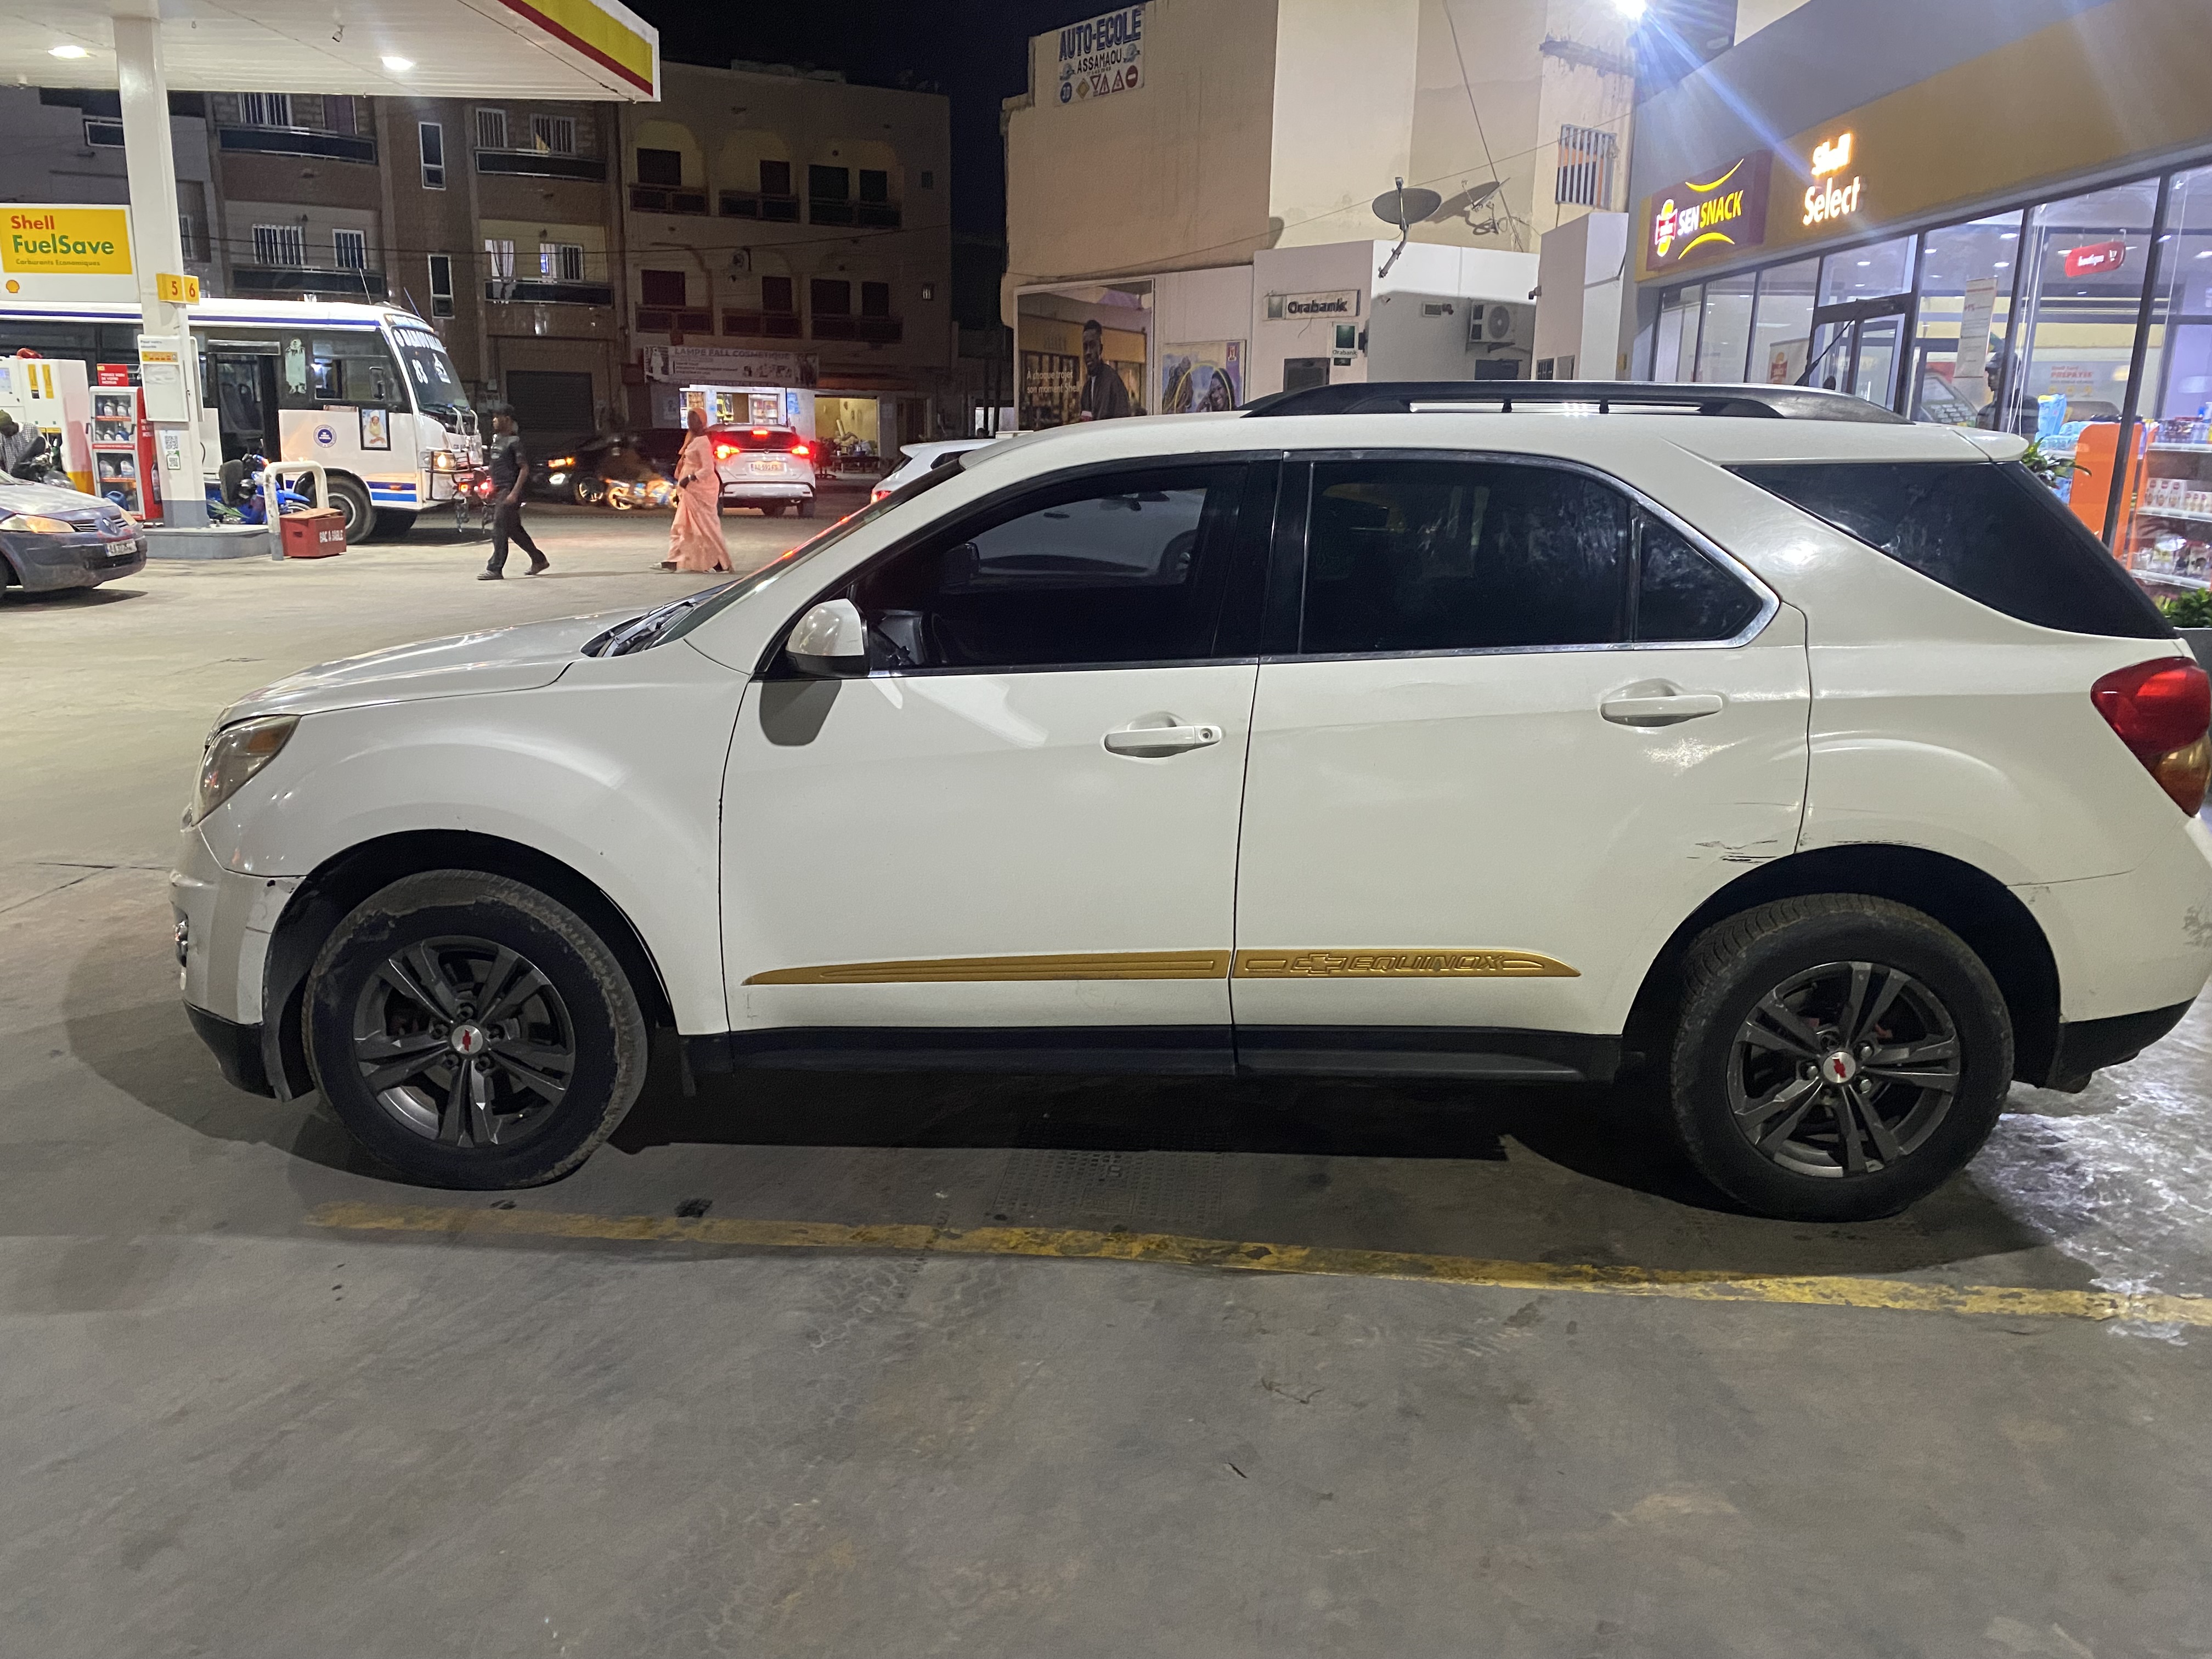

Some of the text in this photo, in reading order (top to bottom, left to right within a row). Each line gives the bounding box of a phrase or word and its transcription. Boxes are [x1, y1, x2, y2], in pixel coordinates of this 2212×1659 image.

[1059, 8, 1142, 62] AUTO-ECOLE
[1077, 48, 1122, 74] ASSAMAOU
[1803, 176, 1860, 226] Select
[1677, 205, 1700, 236] SEN
[1700, 190, 1743, 228] SNACK
[10, 215, 55, 229] Shell
[12, 233, 115, 255] FuelSave
[172, 281, 178, 295] 5
[189, 283, 195, 297] 6
[1288, 298, 1348, 314] Orabank
[675, 348, 706, 356] LAMPE
[709, 349, 732, 357] FALL
[1039, 384, 1063, 393] moment
[1064, 381, 1080, 392] Shell
[1347, 956, 1504, 972] EQUINOX
